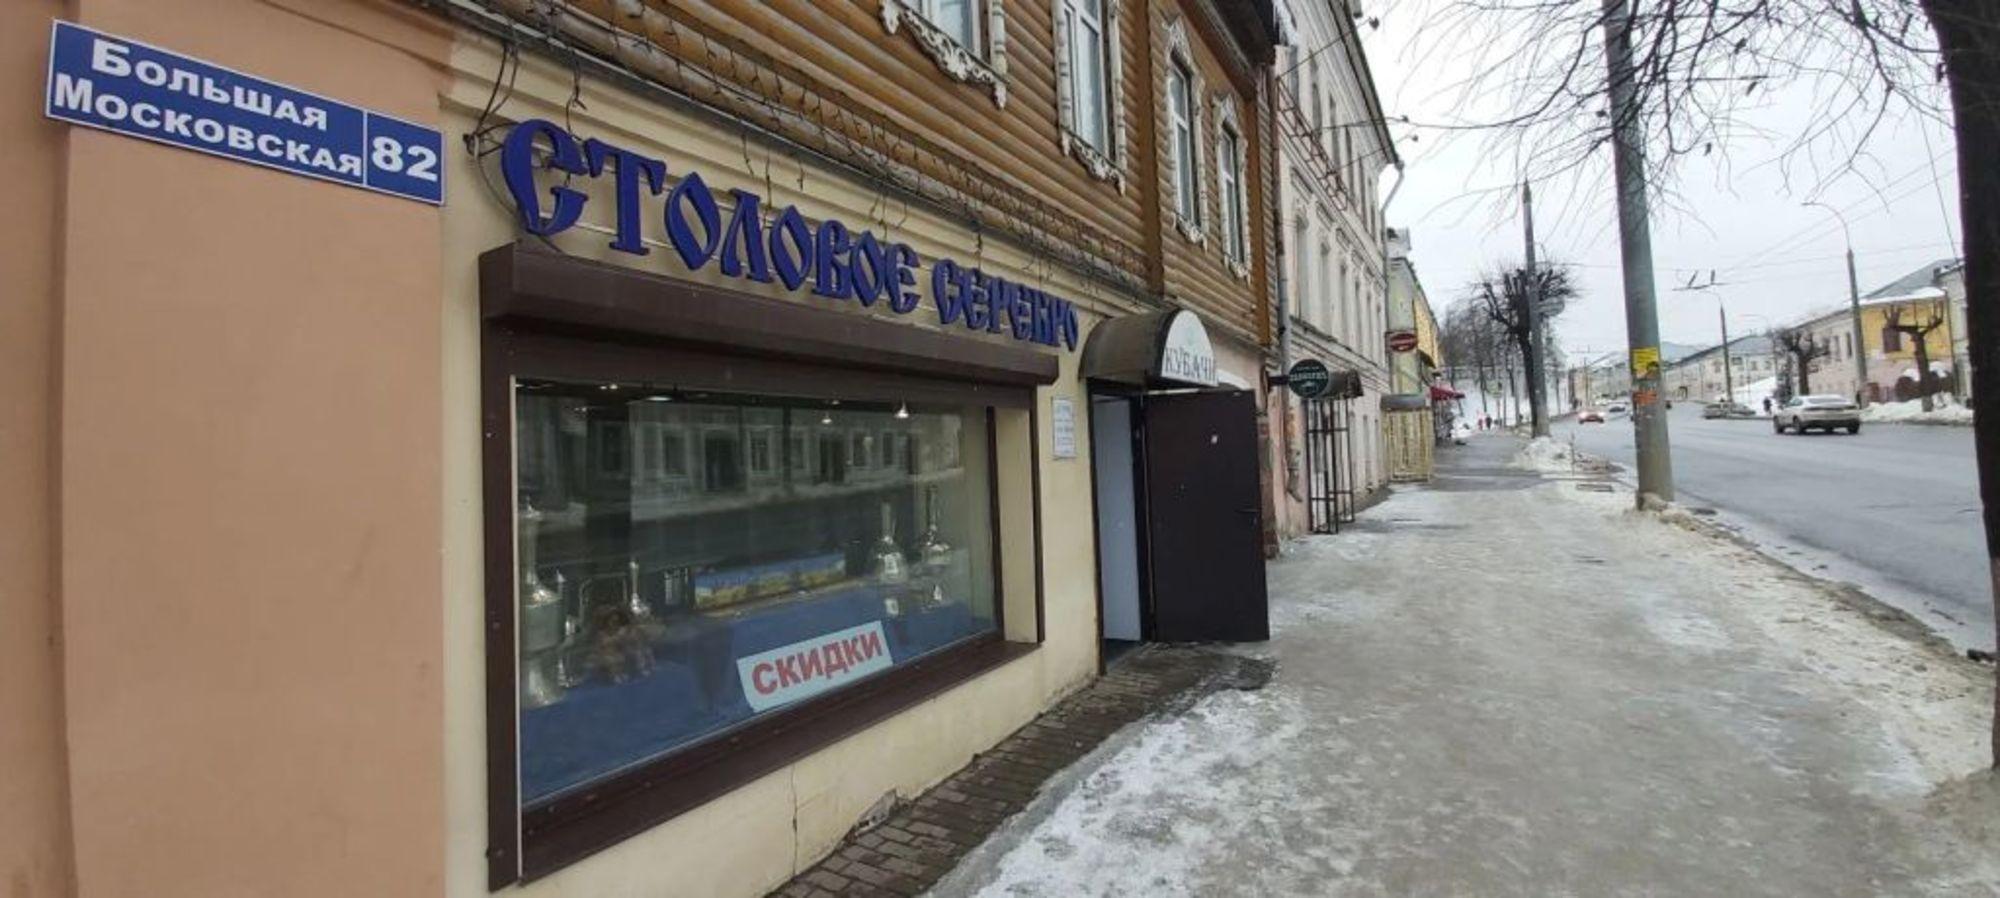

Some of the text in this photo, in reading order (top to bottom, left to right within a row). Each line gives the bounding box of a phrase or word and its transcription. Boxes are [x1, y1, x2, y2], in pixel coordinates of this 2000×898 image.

[371, 135, 437, 182] 82
[501, 119, 1078, 352] СТОЛОВОЕ СЕРЕБРО
[752, 630, 882, 695] СКИДКИ
